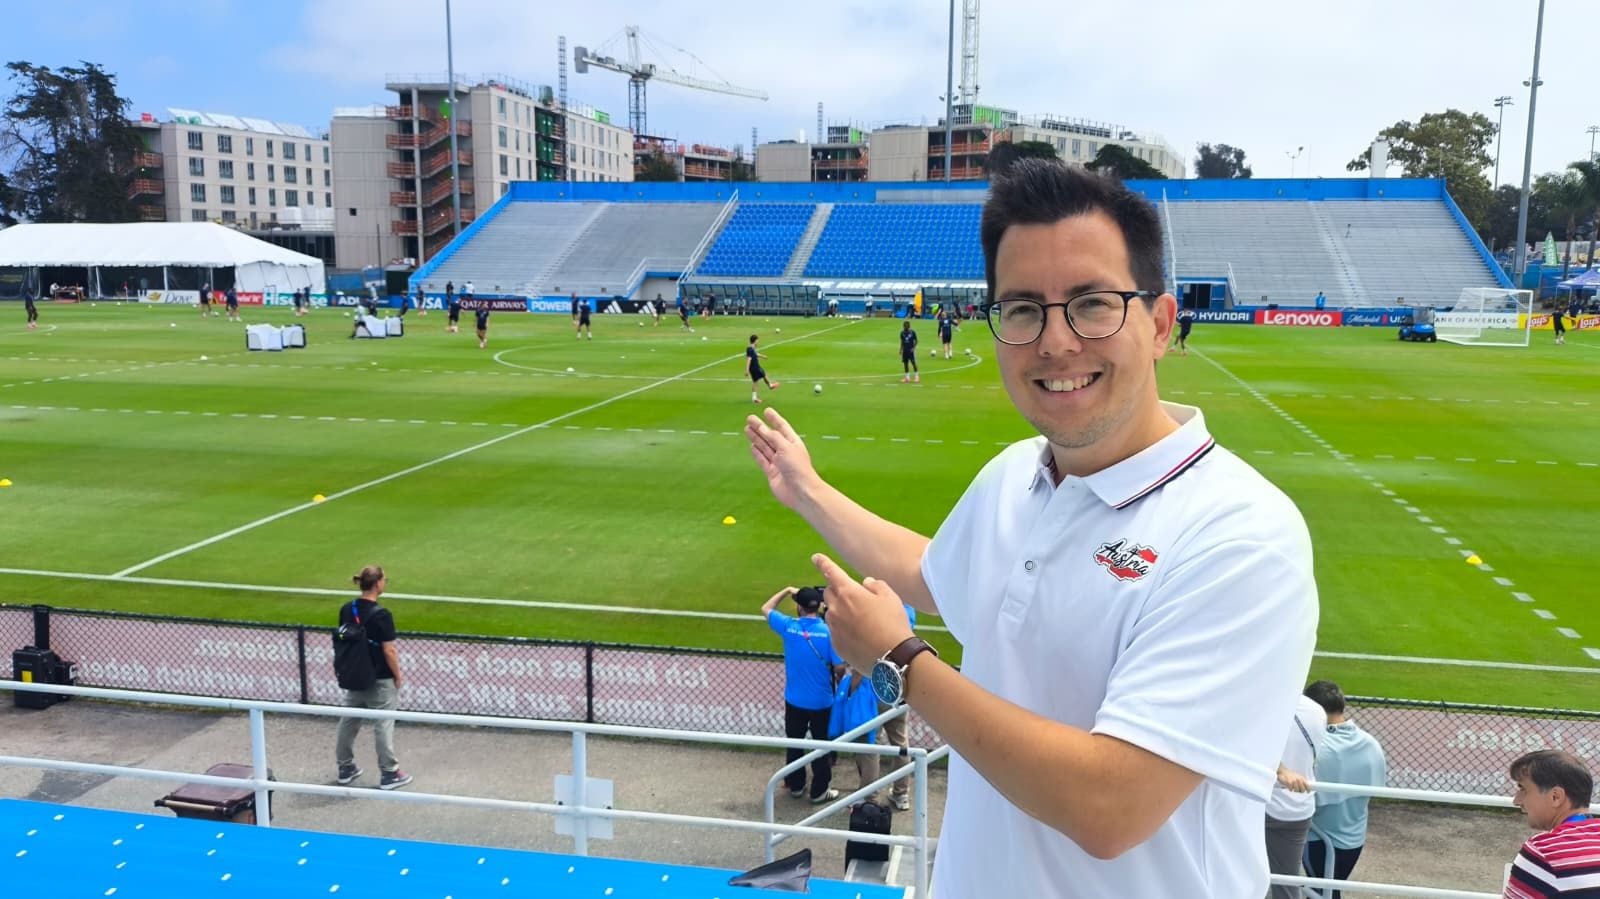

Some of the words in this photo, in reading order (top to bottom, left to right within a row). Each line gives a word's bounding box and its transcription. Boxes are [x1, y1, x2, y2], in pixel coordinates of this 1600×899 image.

[165, 292, 193, 304] Dove
[262, 292, 328, 306] Hisese
[411, 296, 443, 309] VISA
[491, 300, 527, 309] AIRWAYS
[1198, 311, 1250, 321] HYUNDAI
[1263, 310, 1332, 326] Lenovo
[1098, 540, 1149, 576] Austria
